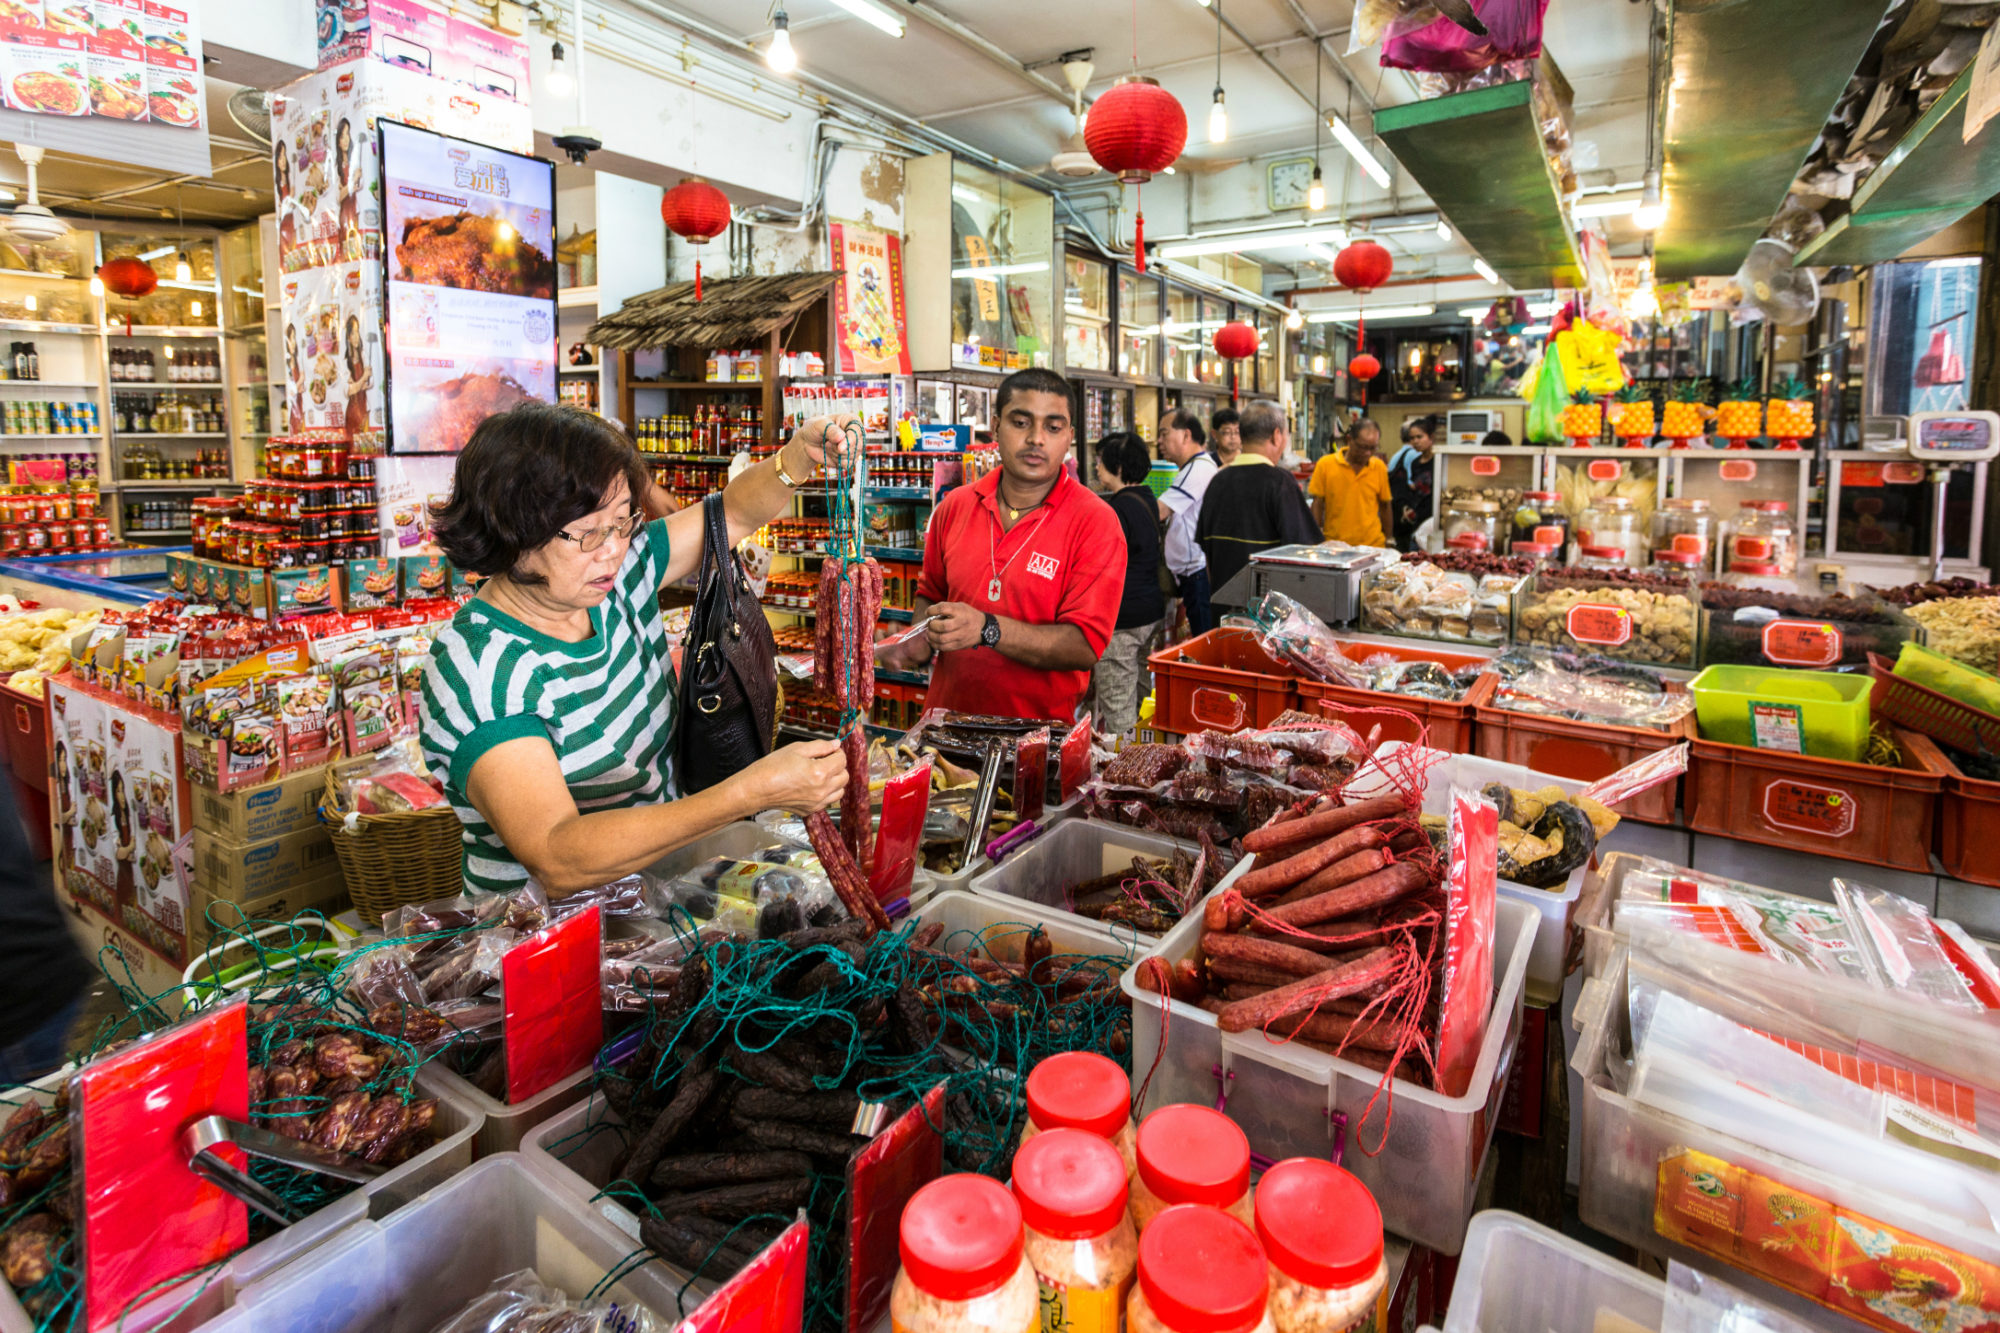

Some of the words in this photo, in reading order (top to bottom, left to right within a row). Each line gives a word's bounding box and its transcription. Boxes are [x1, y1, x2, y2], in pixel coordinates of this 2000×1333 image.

[1031, 556, 1053, 573] AIA
[350, 592, 374, 603] Satay
[250, 790, 280, 807] Heng's
[276, 813, 303, 825] SAUCE
